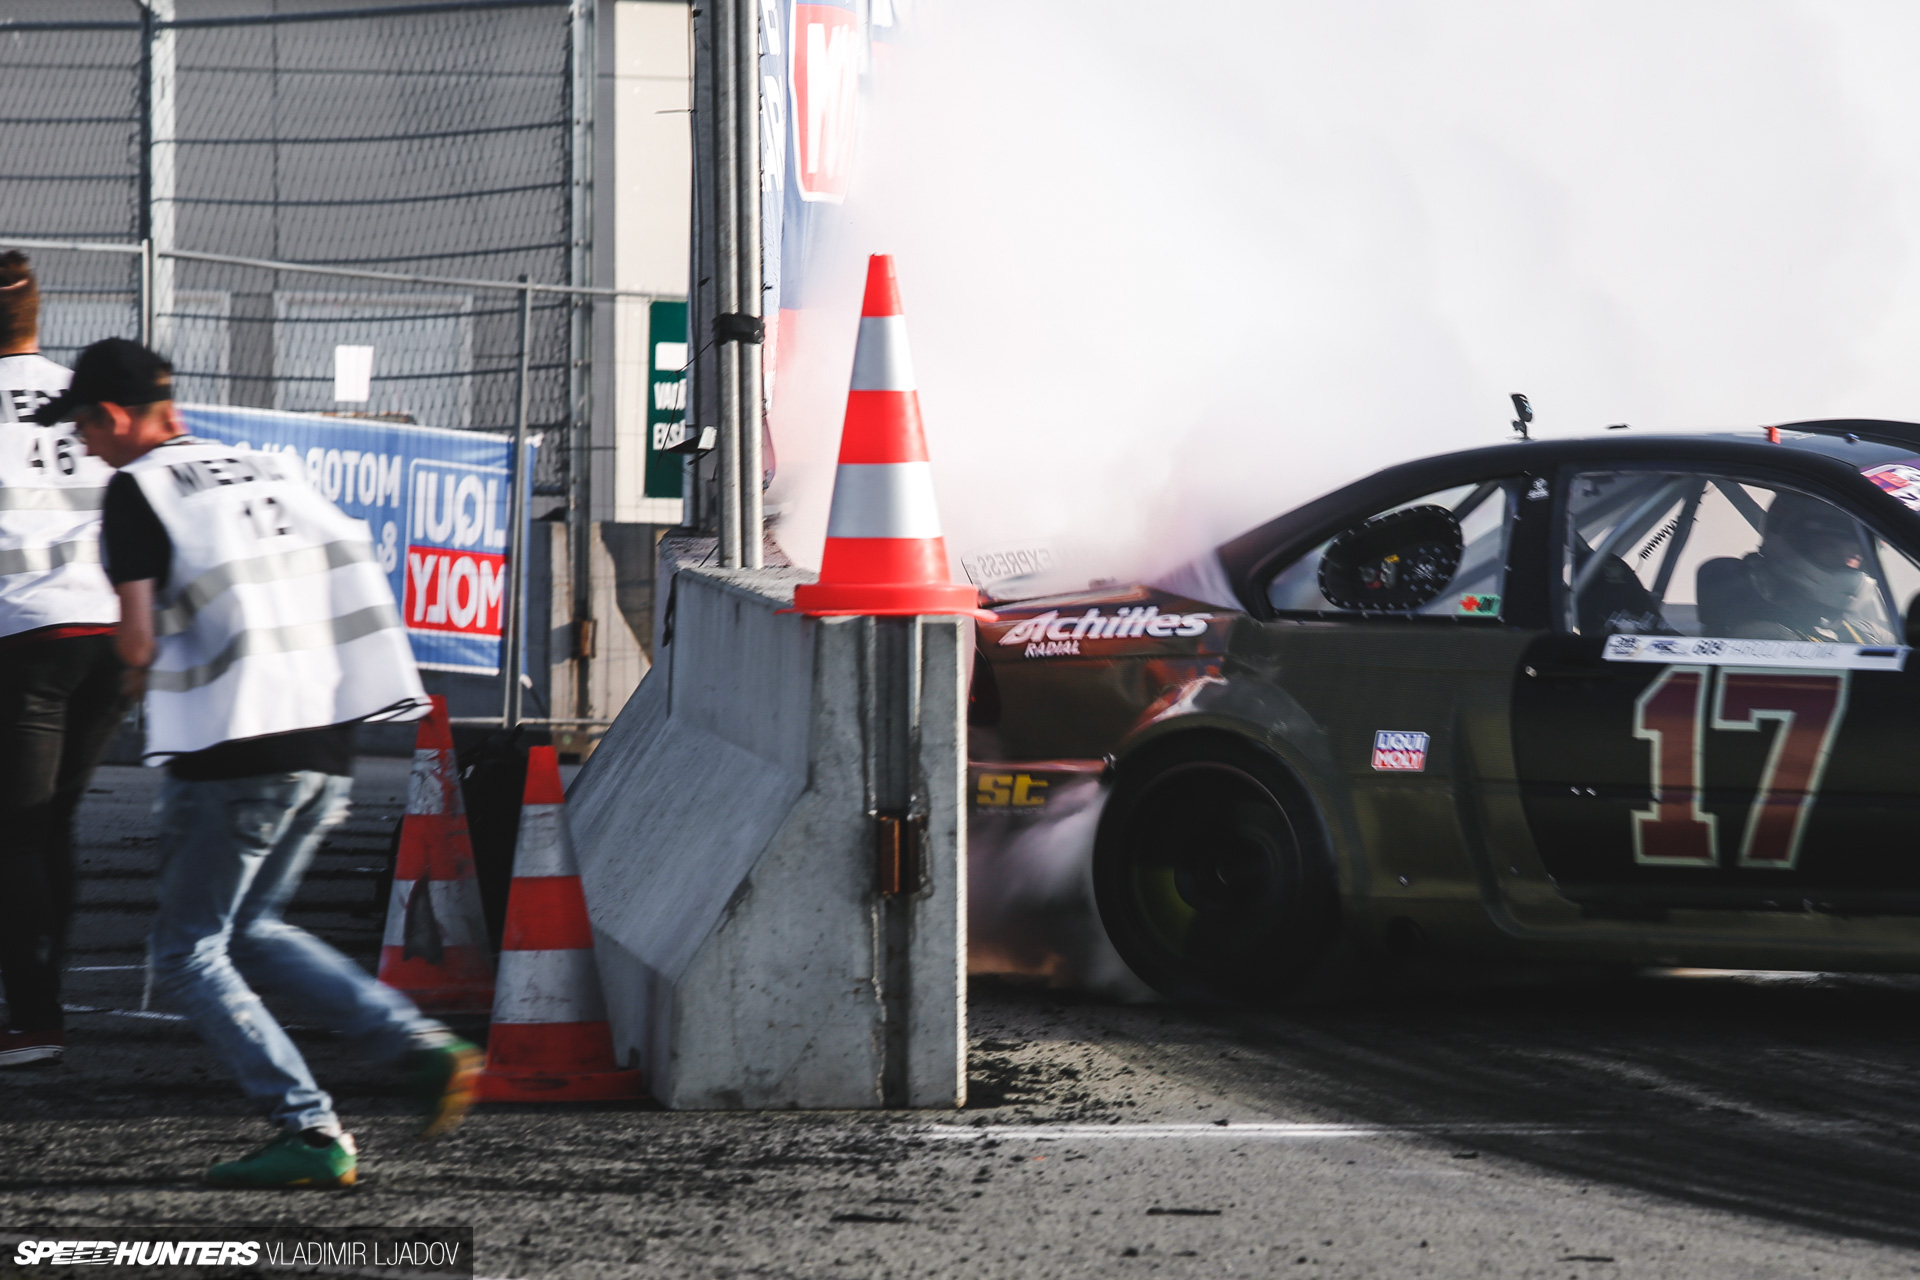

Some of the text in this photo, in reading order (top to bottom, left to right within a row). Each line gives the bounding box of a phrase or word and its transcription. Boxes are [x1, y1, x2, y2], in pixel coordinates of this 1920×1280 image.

[26, 437, 76, 476] 46
[240, 496, 292, 540] 12
[998, 605, 1214, 646] Achilles
[1023, 639, 1081, 658] RADIAL
[1373, 750, 1425, 769] MOLY
[1376, 732, 1426, 751] LIQUI
[1630, 664, 1853, 870] 17
